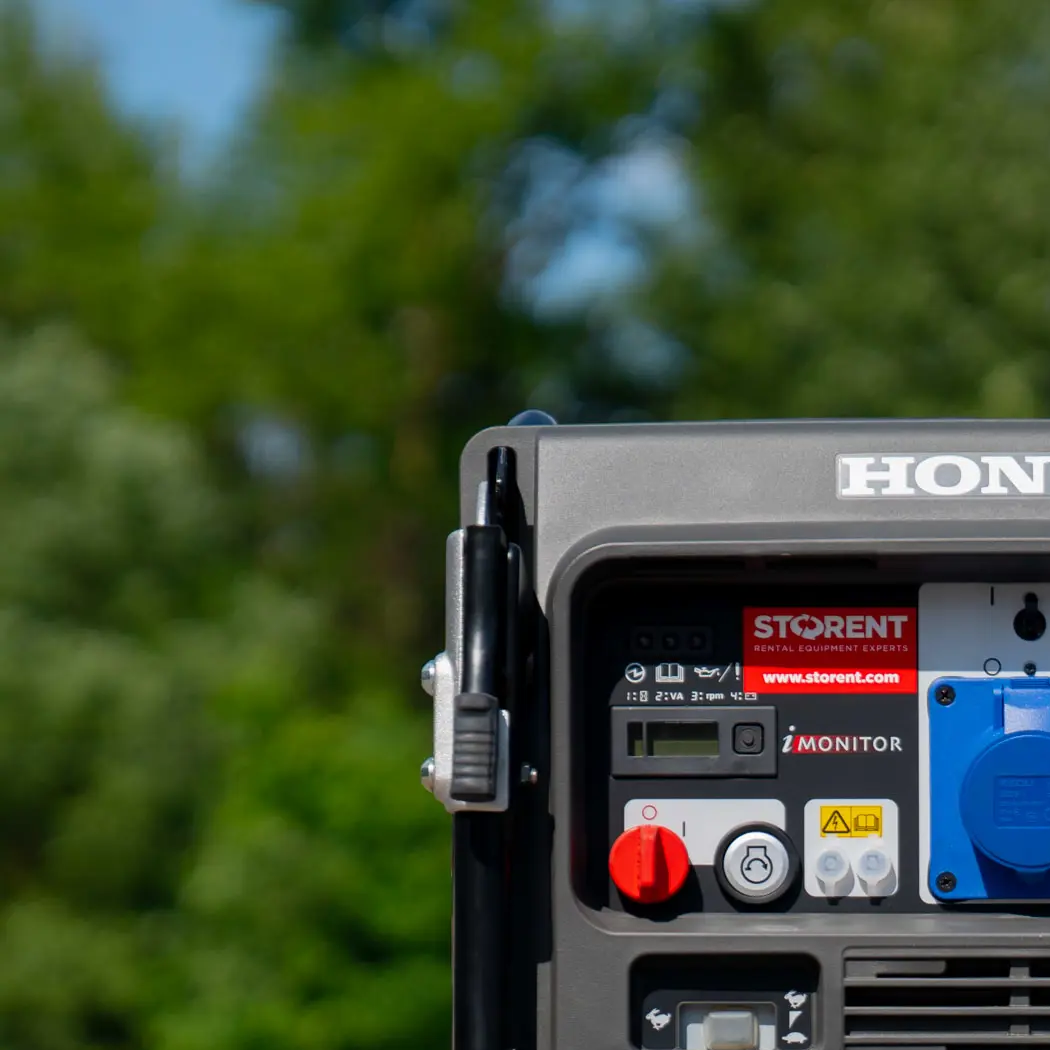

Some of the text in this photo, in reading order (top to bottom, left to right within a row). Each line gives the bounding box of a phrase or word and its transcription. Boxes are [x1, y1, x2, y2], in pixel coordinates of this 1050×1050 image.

[754, 613, 908, 640] STORENT
[754, 644, 909, 652] RENTAL EQUIPMENT EXPERTS
[763, 671, 900, 684] www.storent.com
